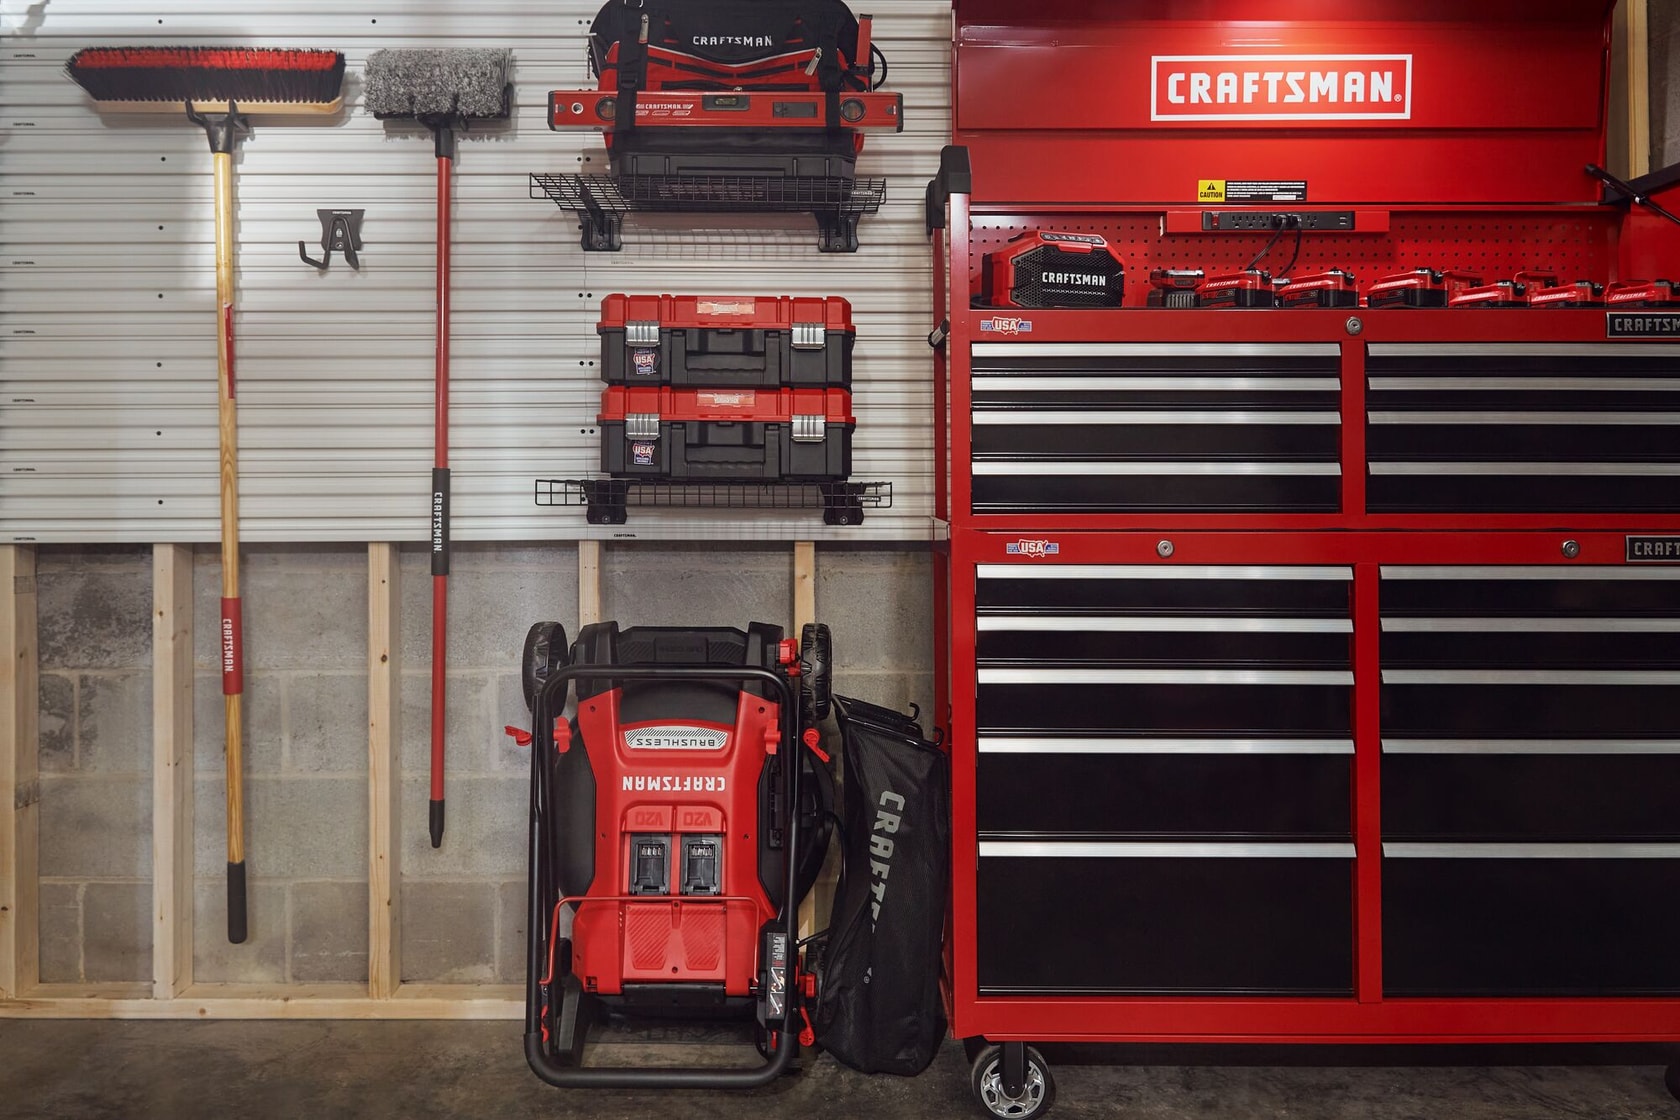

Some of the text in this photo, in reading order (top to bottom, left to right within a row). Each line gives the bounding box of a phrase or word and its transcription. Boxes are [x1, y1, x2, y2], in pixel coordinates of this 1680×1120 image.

[693, 35, 773, 47] CRAFTSMAN
[1042, 272, 1106, 286] CRAFTSMAN
[1206, 280, 1240, 288] CRAFTSMAN
[995, 320, 1017, 331] USA
[635, 446, 651, 454] USA
[433, 492, 443, 552] CRAFTSMAN
[1021, 542, 1044, 553] USA
[223, 618, 234, 673] CRAFTSMAN
[636, 738, 715, 747] BRUSHLESS
[622, 776, 726, 791] CRAFTSMAN
[635, 811, 664, 826] V20
[683, 812, 713, 826] V20
